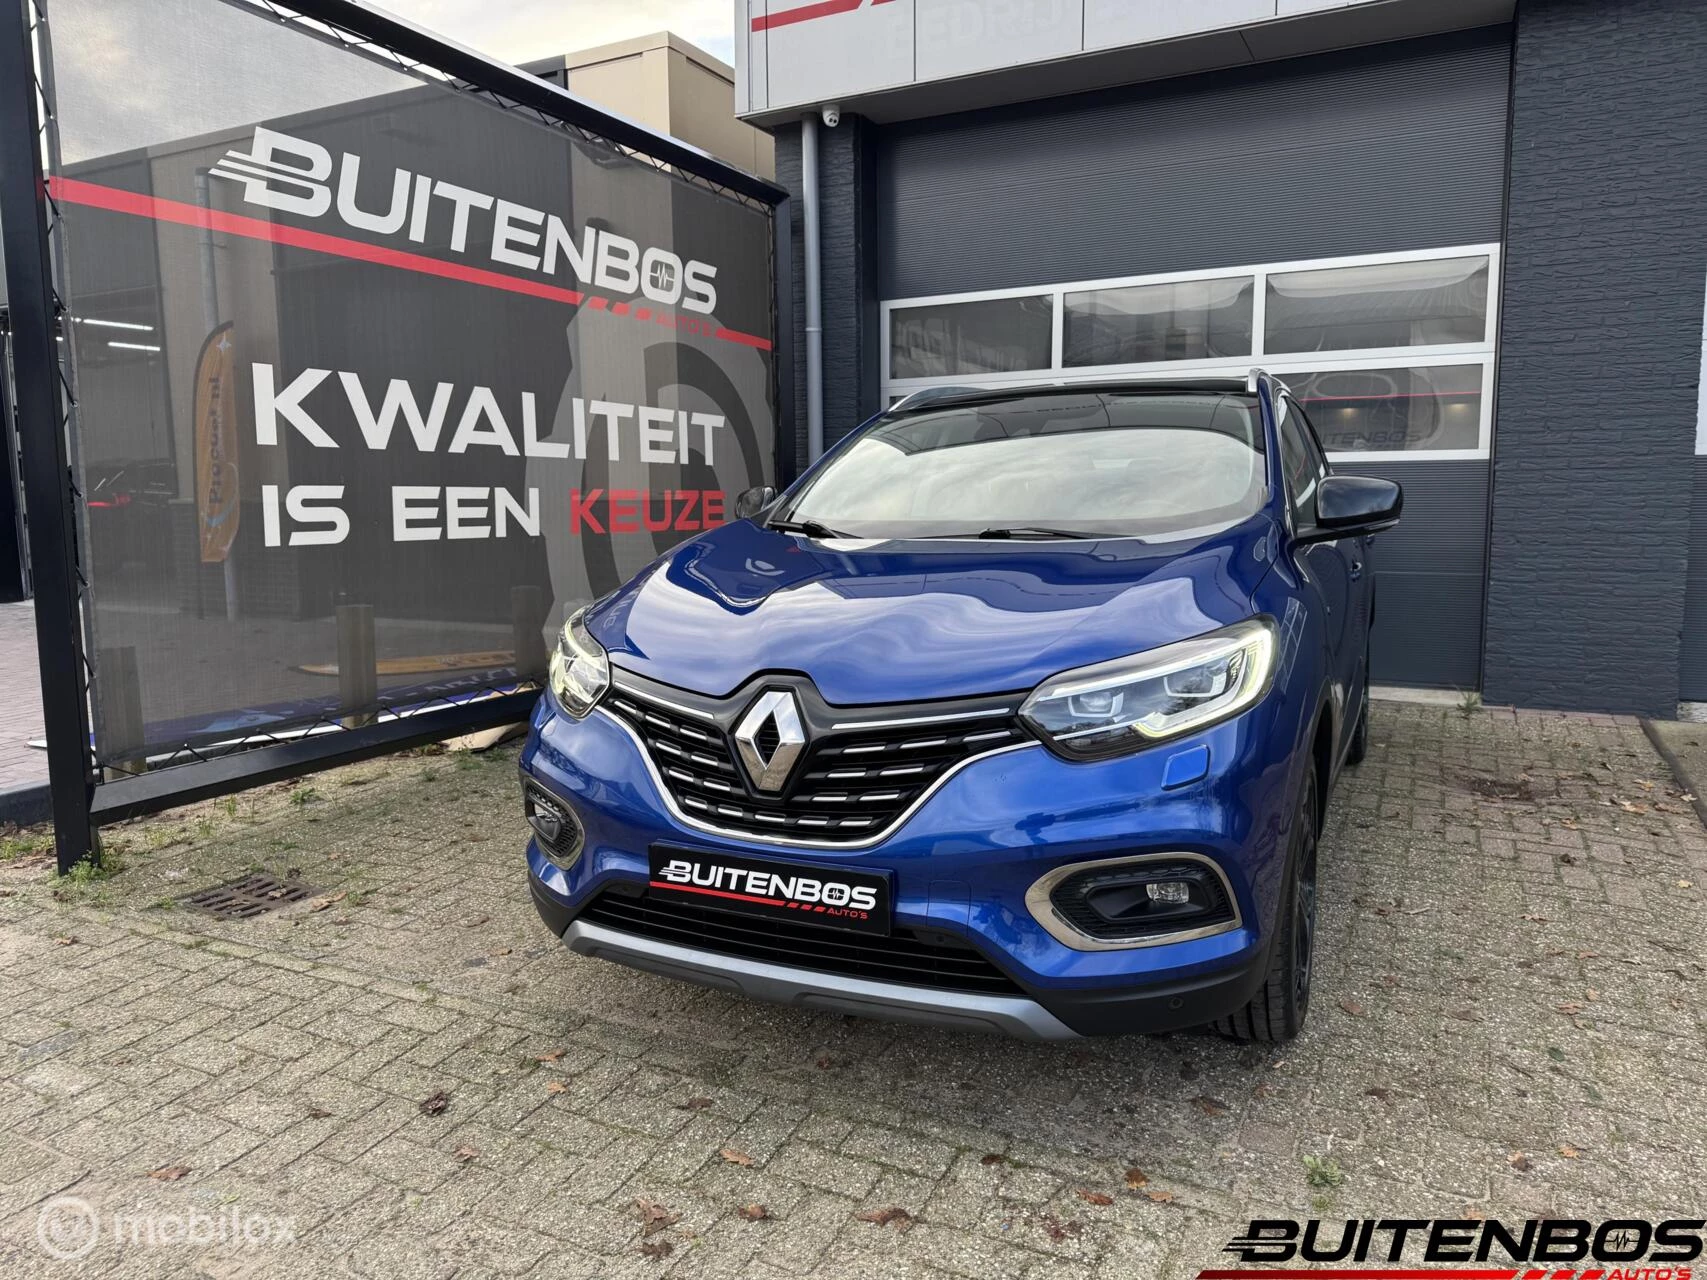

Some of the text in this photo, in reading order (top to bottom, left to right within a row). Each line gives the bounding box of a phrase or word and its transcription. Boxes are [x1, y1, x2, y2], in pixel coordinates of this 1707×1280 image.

[208, 126, 718, 315] BUITENBOS
[252, 362, 726, 467] KWALITEIT
[261, 484, 727, 548] IS EEN KEUZE
[658, 859, 878, 911] BUITENBOS
[826, 907, 869, 921] AUTO'S
